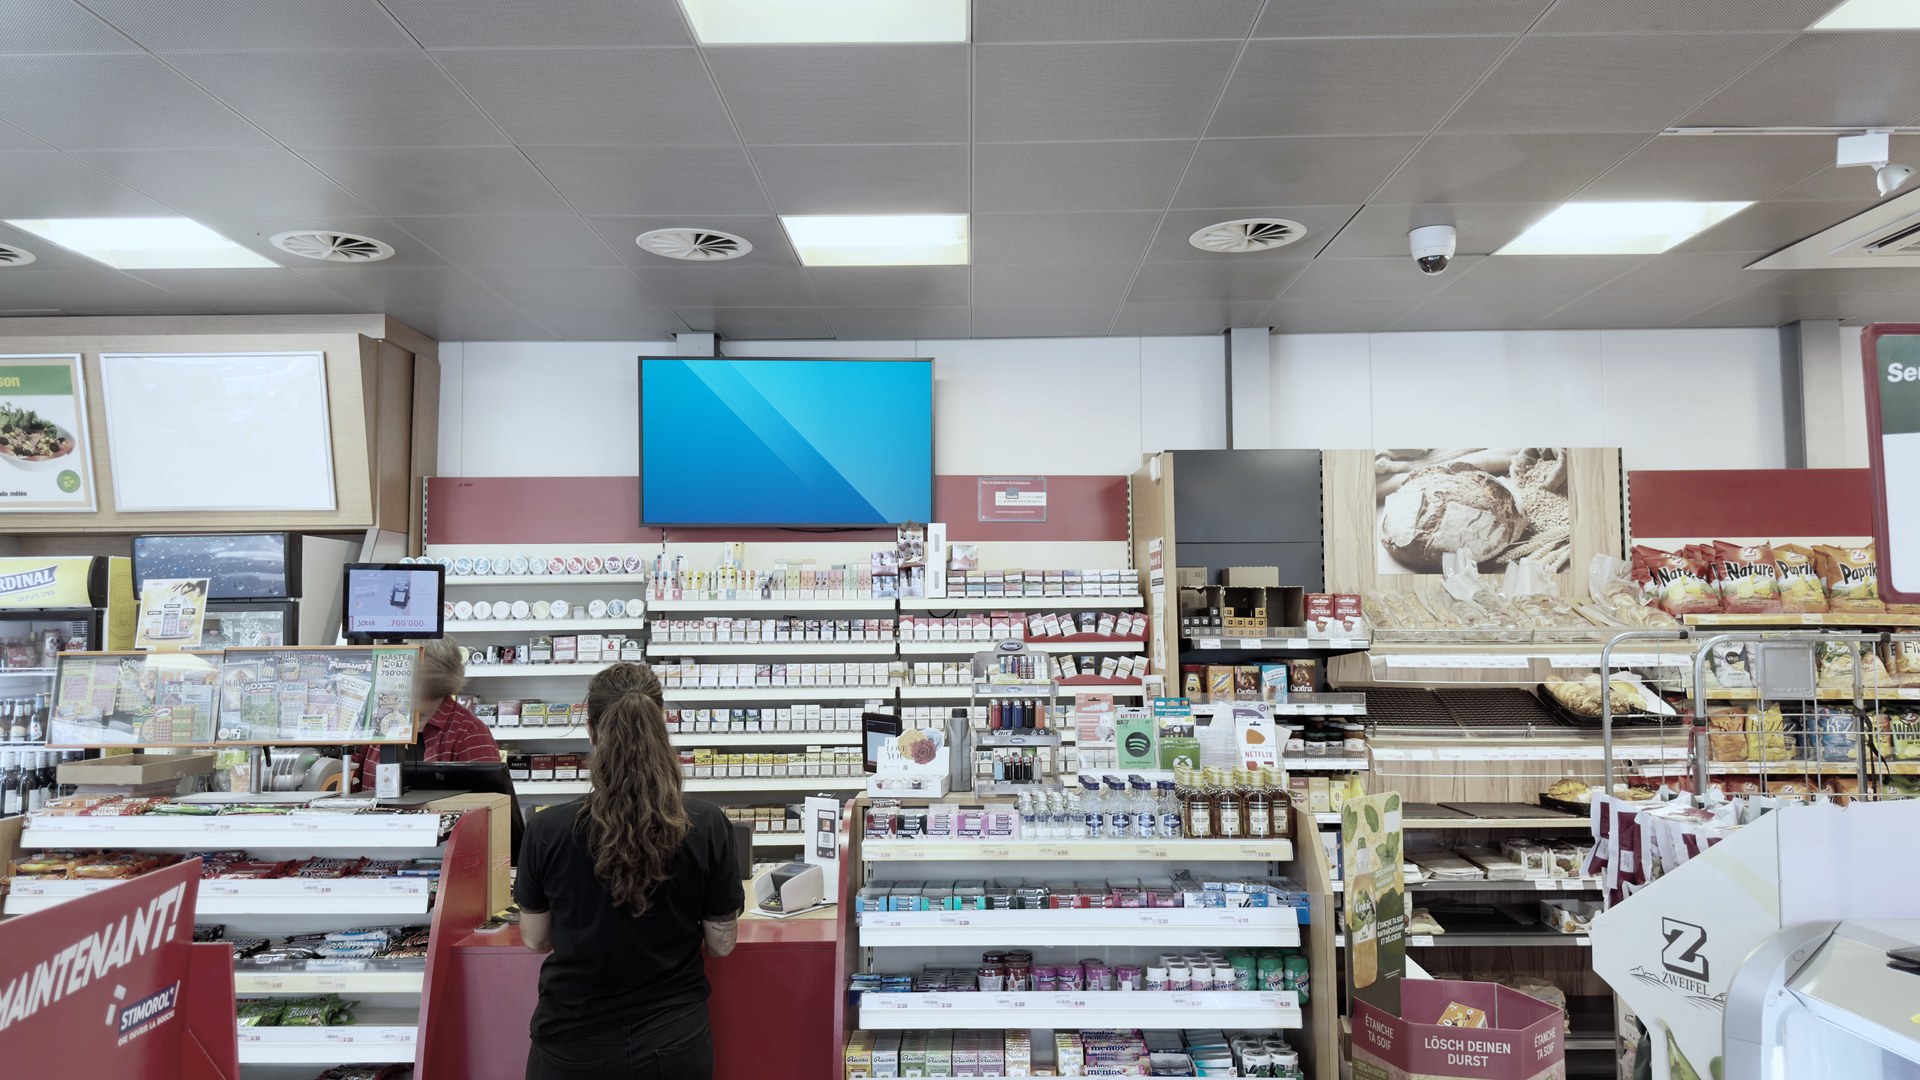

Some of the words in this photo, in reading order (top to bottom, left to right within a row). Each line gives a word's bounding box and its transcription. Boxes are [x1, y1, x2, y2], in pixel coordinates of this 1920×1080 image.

[1887, 362, 1920, 382] Se
[1724, 562, 1774, 582] Nature
[1290, 684, 1313, 693] Caotina
[1244, 750, 1274, 759] NETFLIX
[1662, 916, 1709, 983] Z
[1662, 971, 1710, 996] ZWEIFEL
[289, 1007, 322, 1018] Balisto
[1365, 1013, 1394, 1040] ÉTANCHE
[1368, 1030, 1376, 1043] TA
[1376, 1033, 1391, 1051] SOIF
[1534, 1027, 1556, 1048] ÉTANCHE
[1091, 1044, 1127, 1052] mentos
[1424, 1035, 1464, 1051] LÖSCH
[1467, 1041, 1511, 1054] DEINEN
[1537, 1048, 1543, 1060] TA
[1543, 1042, 1554, 1058] SOIF
[847, 1055, 869, 1064] Ricola
[874, 1055, 896, 1064] Ricola
[902, 1054, 924, 1063] Ricola
[927, 1056, 949, 1065] Ricola
[954, 1056, 976, 1064] Ricola
[980, 1056, 1002, 1064] Ricola
[1448, 1053, 1488, 1067] DURST
[1088, 1068, 1123, 1076] mentos
